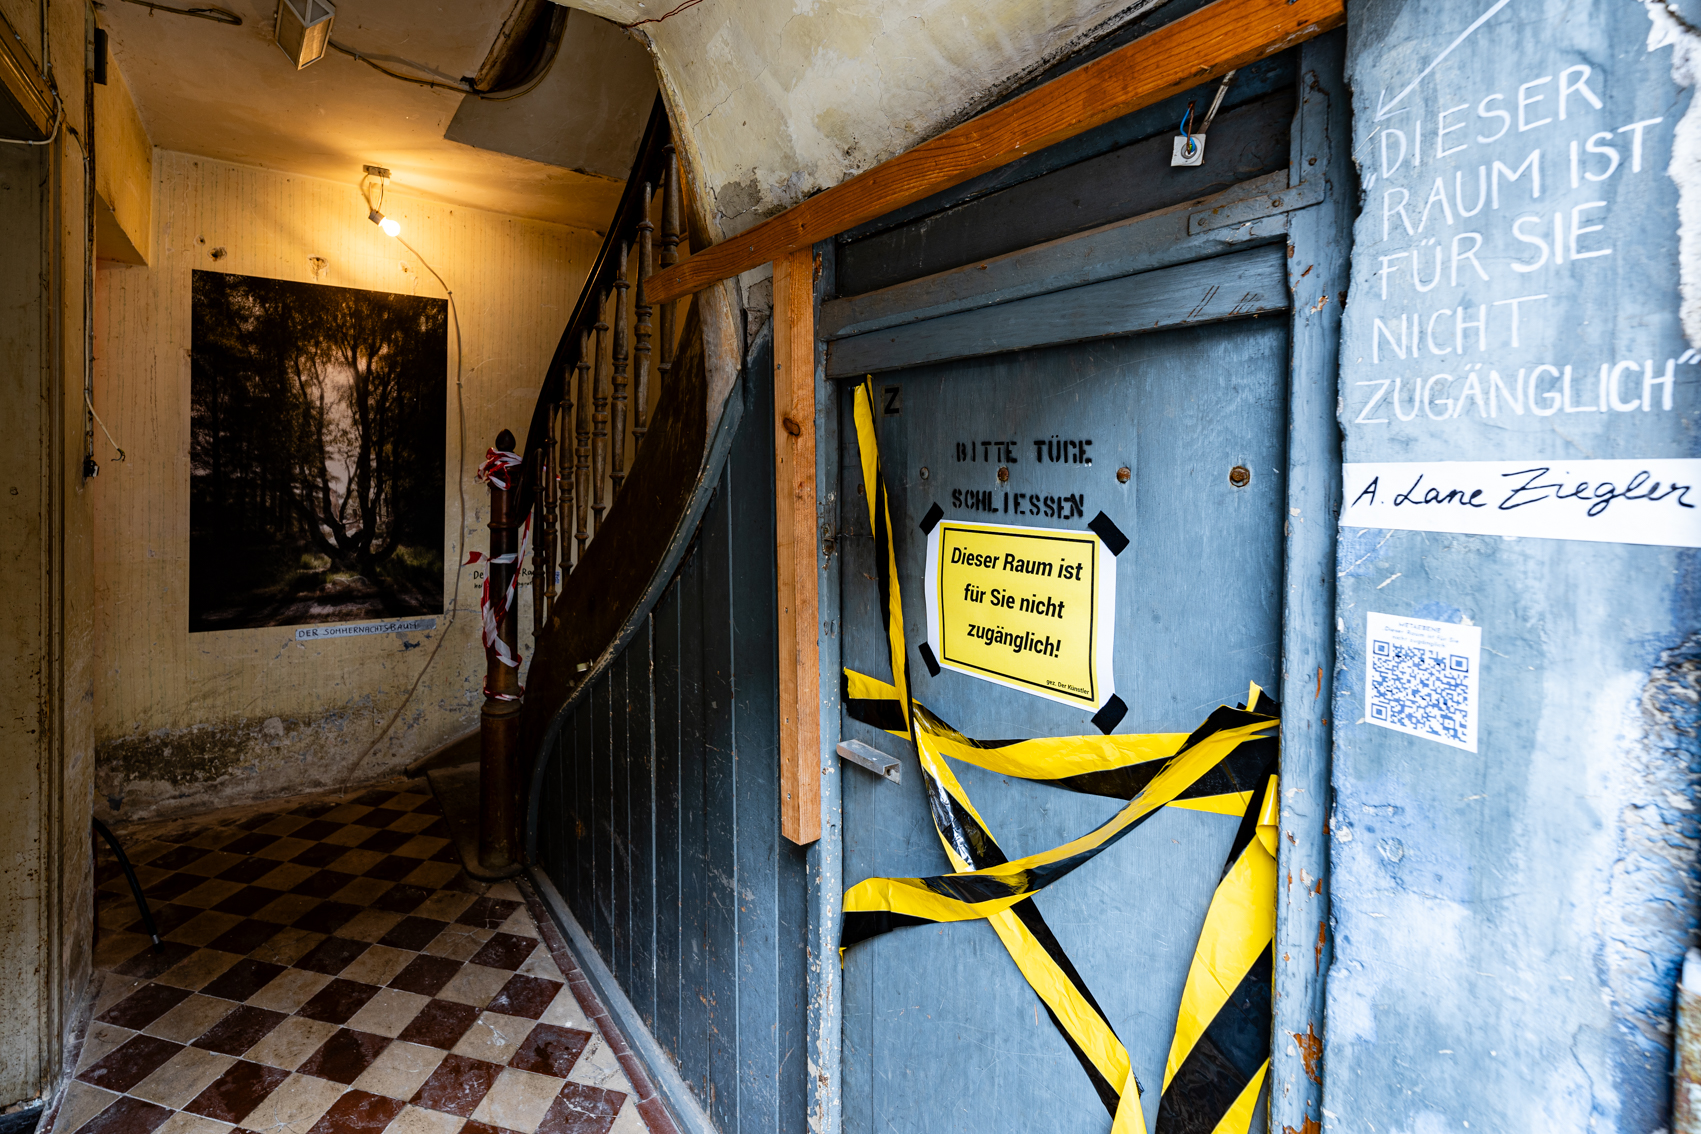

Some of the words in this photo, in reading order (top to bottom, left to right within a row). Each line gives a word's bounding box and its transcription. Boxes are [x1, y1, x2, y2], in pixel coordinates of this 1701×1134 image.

[1383, 149, 1541, 241] RAUM
[1570, 116, 1664, 189] IST
[1378, 232, 1489, 300] FÜR
[1510, 201, 1613, 273] SIE
[1373, 294, 1549, 364] NICHT
[956, 441, 1018, 463] BITTE
[1033, 434, 1093, 464] TÜRE
[951, 488, 1084, 520] SCHLIESSEN
[1351, 475, 1385, 507] A.
[1393, 474, 1488, 507] Lane
[1498, 467, 1696, 517] Ziegler
[951, 546, 1000, 569] Dieser
[1002, 552, 1053, 577] Raum
[1057, 558, 1083, 581] ist
[964, 583, 986, 604] für
[990, 588, 1015, 609] Sie
[1019, 593, 1065, 619] nicht
[298, 628, 319, 638] DER
[966, 623, 1062, 658] zugänglich!
[1057, 681, 1067, 689] Der
[1067, 684, 1090, 695] Künstler
